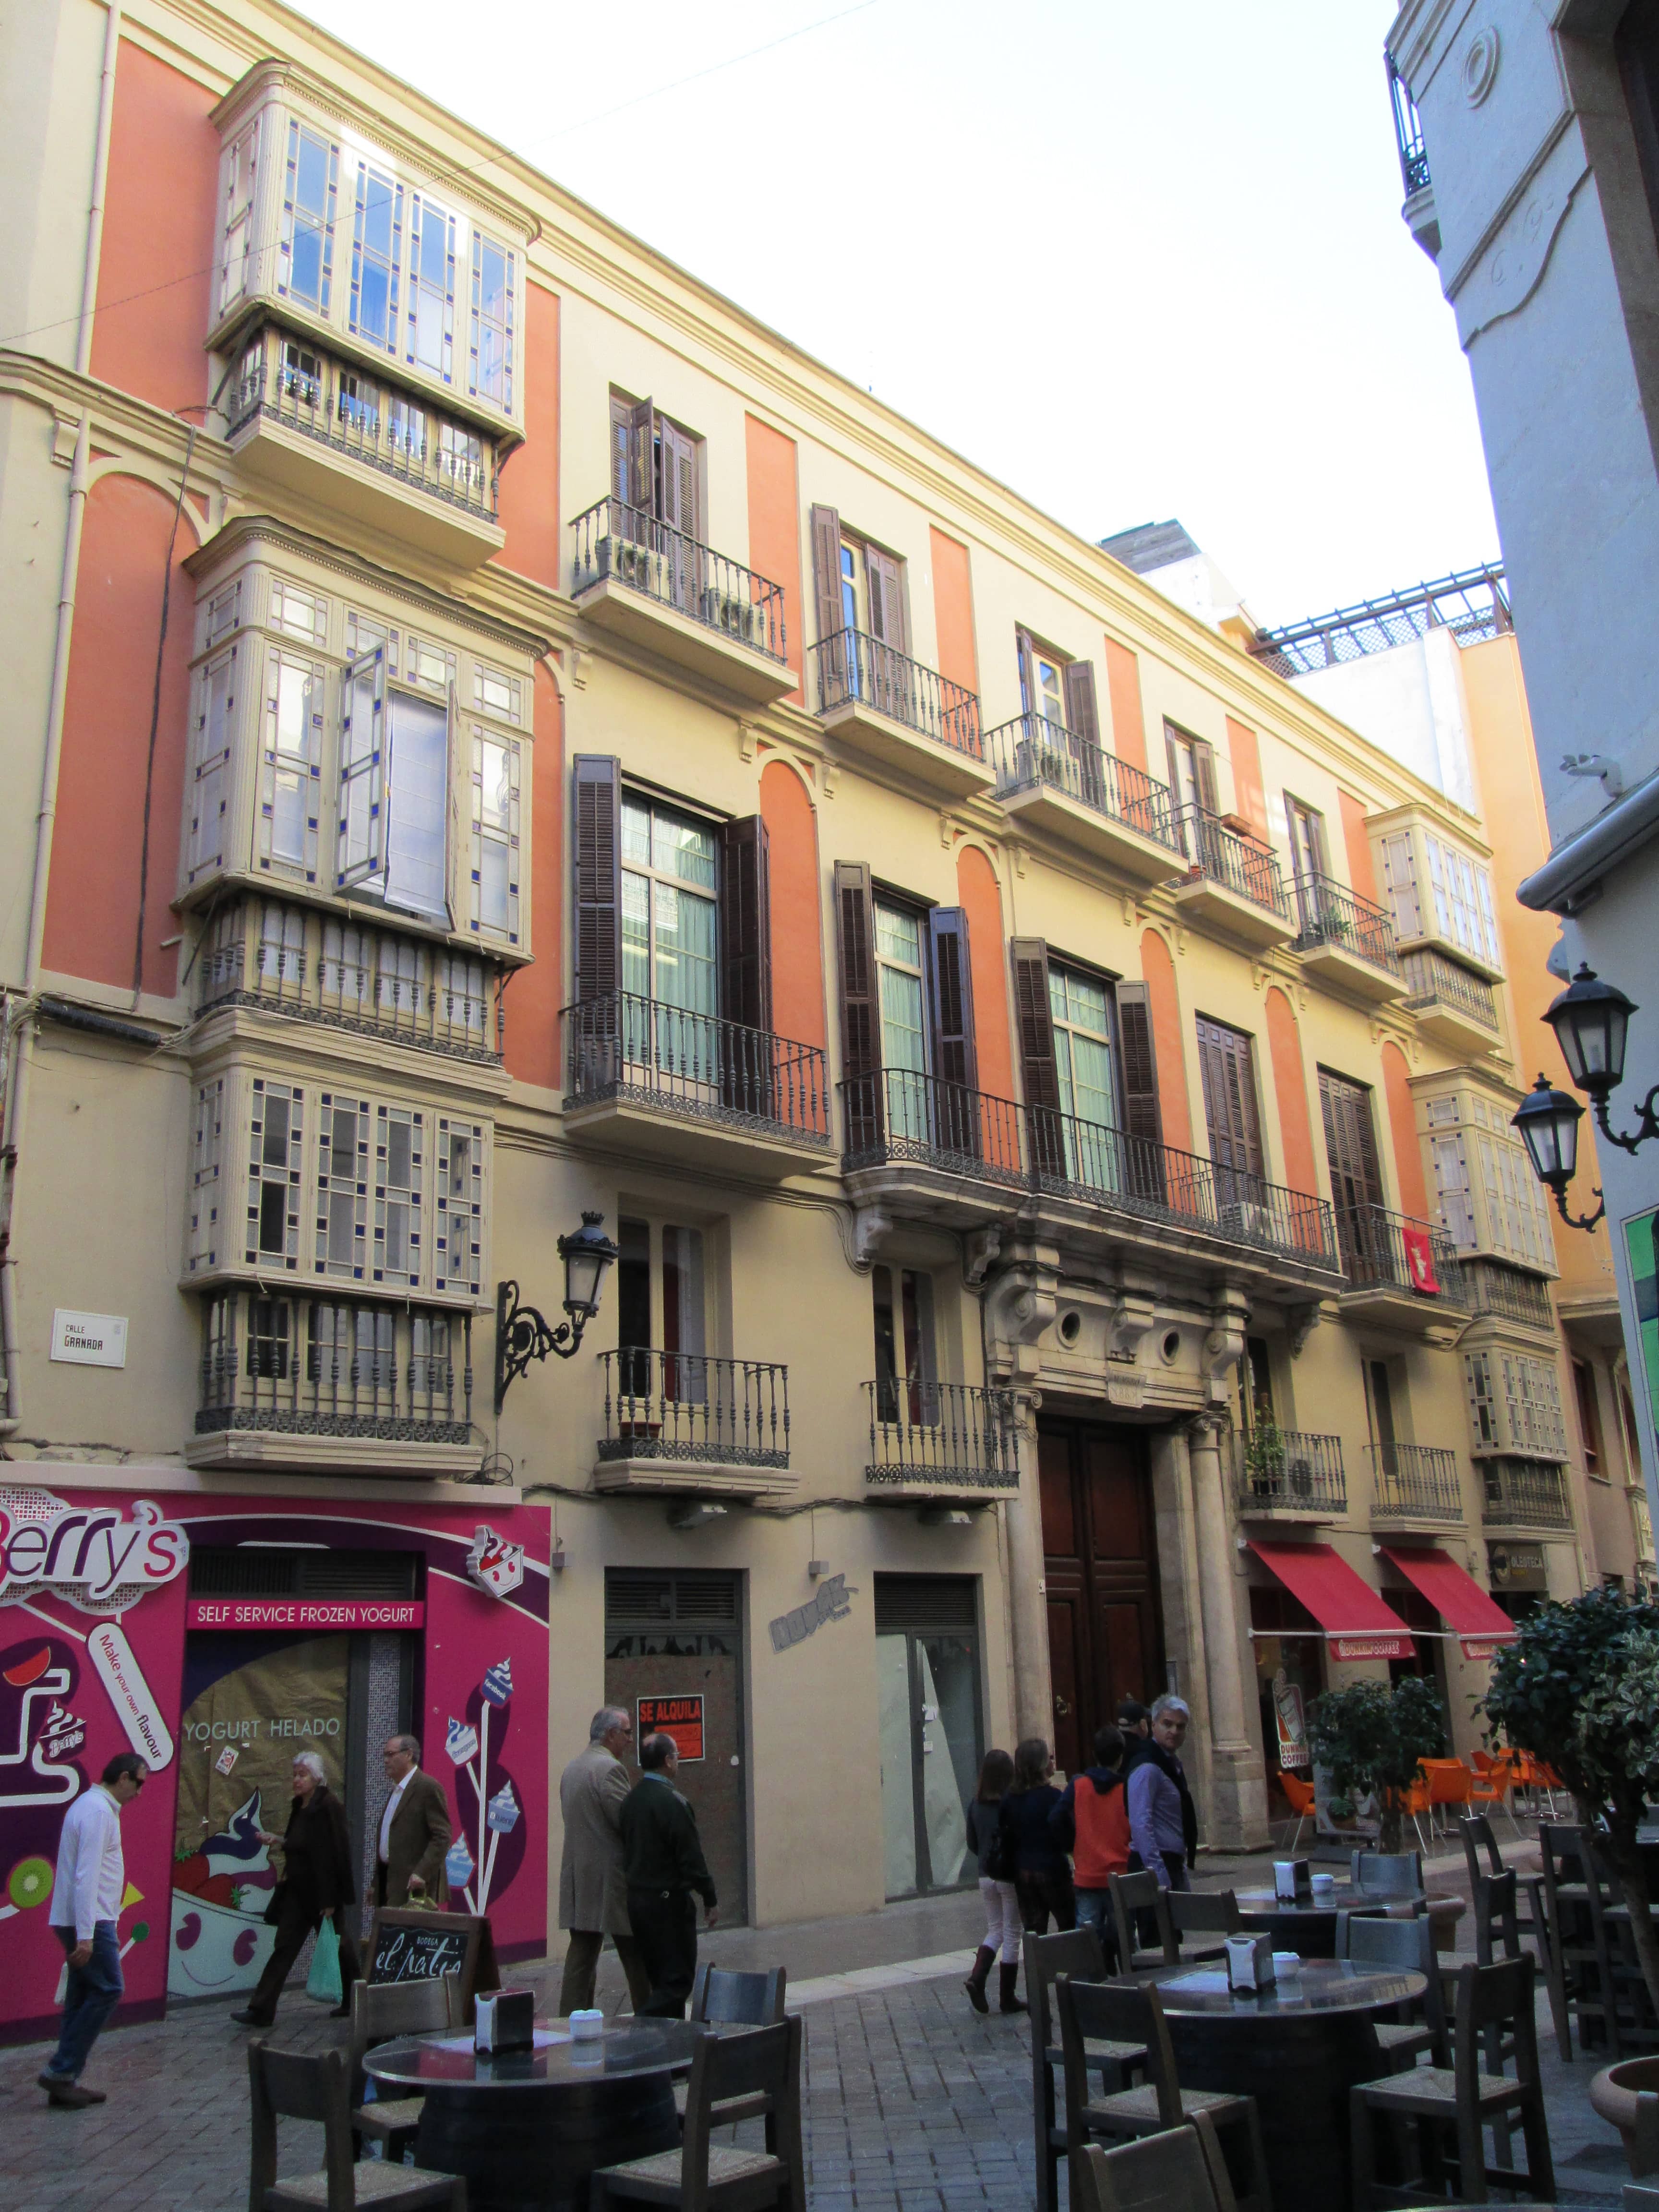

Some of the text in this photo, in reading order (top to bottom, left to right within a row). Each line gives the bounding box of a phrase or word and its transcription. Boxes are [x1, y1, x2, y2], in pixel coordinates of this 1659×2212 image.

[65, 1324, 84, 1334] CALLE
[64, 1335, 103, 1350] GRANADA
[197, 1606, 415, 1622] SELF SERVICE FROZEN YOGURT
[1373, 1640, 1400, 1654] COFFEE
[99, 1634, 162, 1759] Make your own flavour
[484, 1678, 506, 1700] facebook
[639, 1700, 701, 1722] SE ALQUILA
[184, 1718, 340, 1741] YOGURT HELADO
[1282, 1754, 1307, 1765] COFFEE
[417, 1936, 438, 1946] BODEGA
[376, 1933, 405, 1971] el
